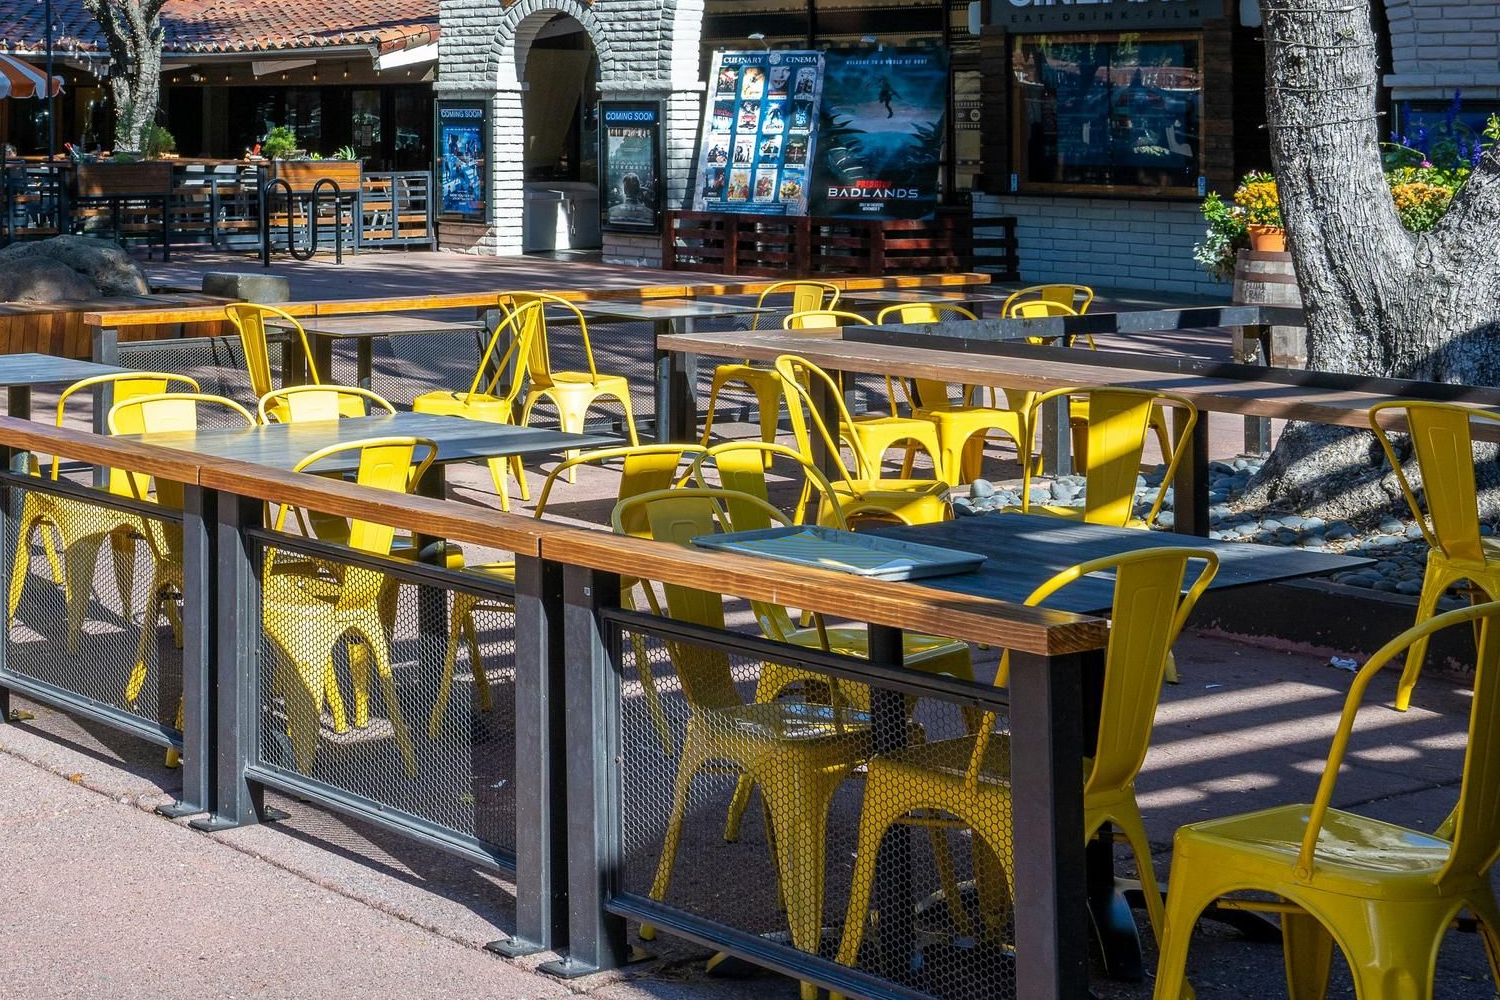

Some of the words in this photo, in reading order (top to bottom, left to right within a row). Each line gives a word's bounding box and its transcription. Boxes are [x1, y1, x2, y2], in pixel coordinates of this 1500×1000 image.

[441, 109, 464, 118] COMING
[465, 109, 482, 118] SOON
[605, 112, 633, 120] COMING
[633, 112, 654, 120] SOON
[827, 187, 919, 199] BADLANDS
